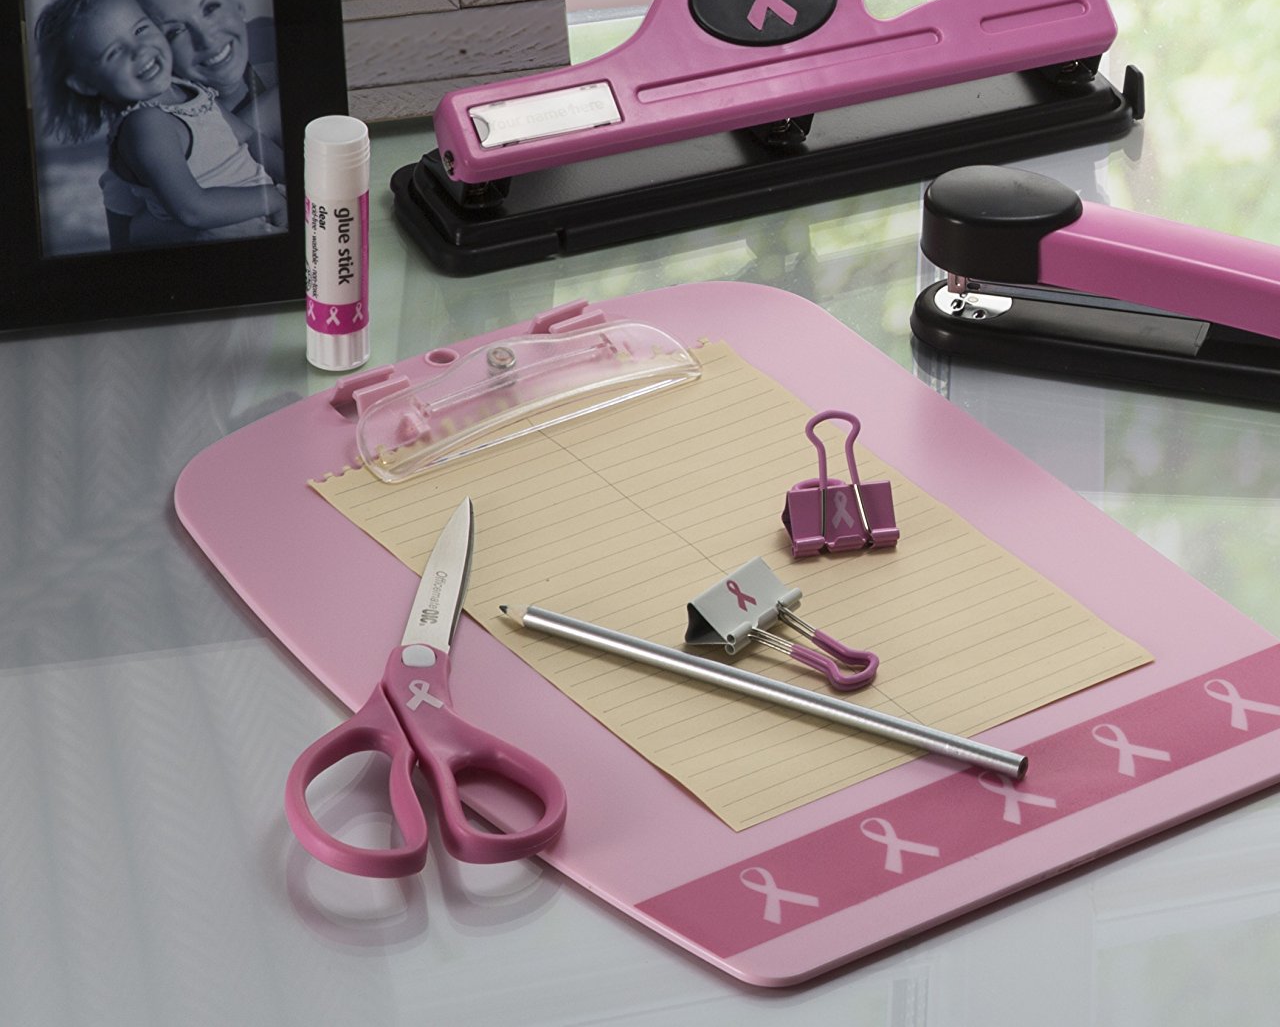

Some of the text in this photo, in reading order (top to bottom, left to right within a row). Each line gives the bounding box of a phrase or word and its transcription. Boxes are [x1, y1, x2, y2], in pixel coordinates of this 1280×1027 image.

[525, 107, 568, 124] name
[568, 99, 605, 116] here
[319, 205, 328, 230] clear
[334, 207, 354, 285] glue stick
